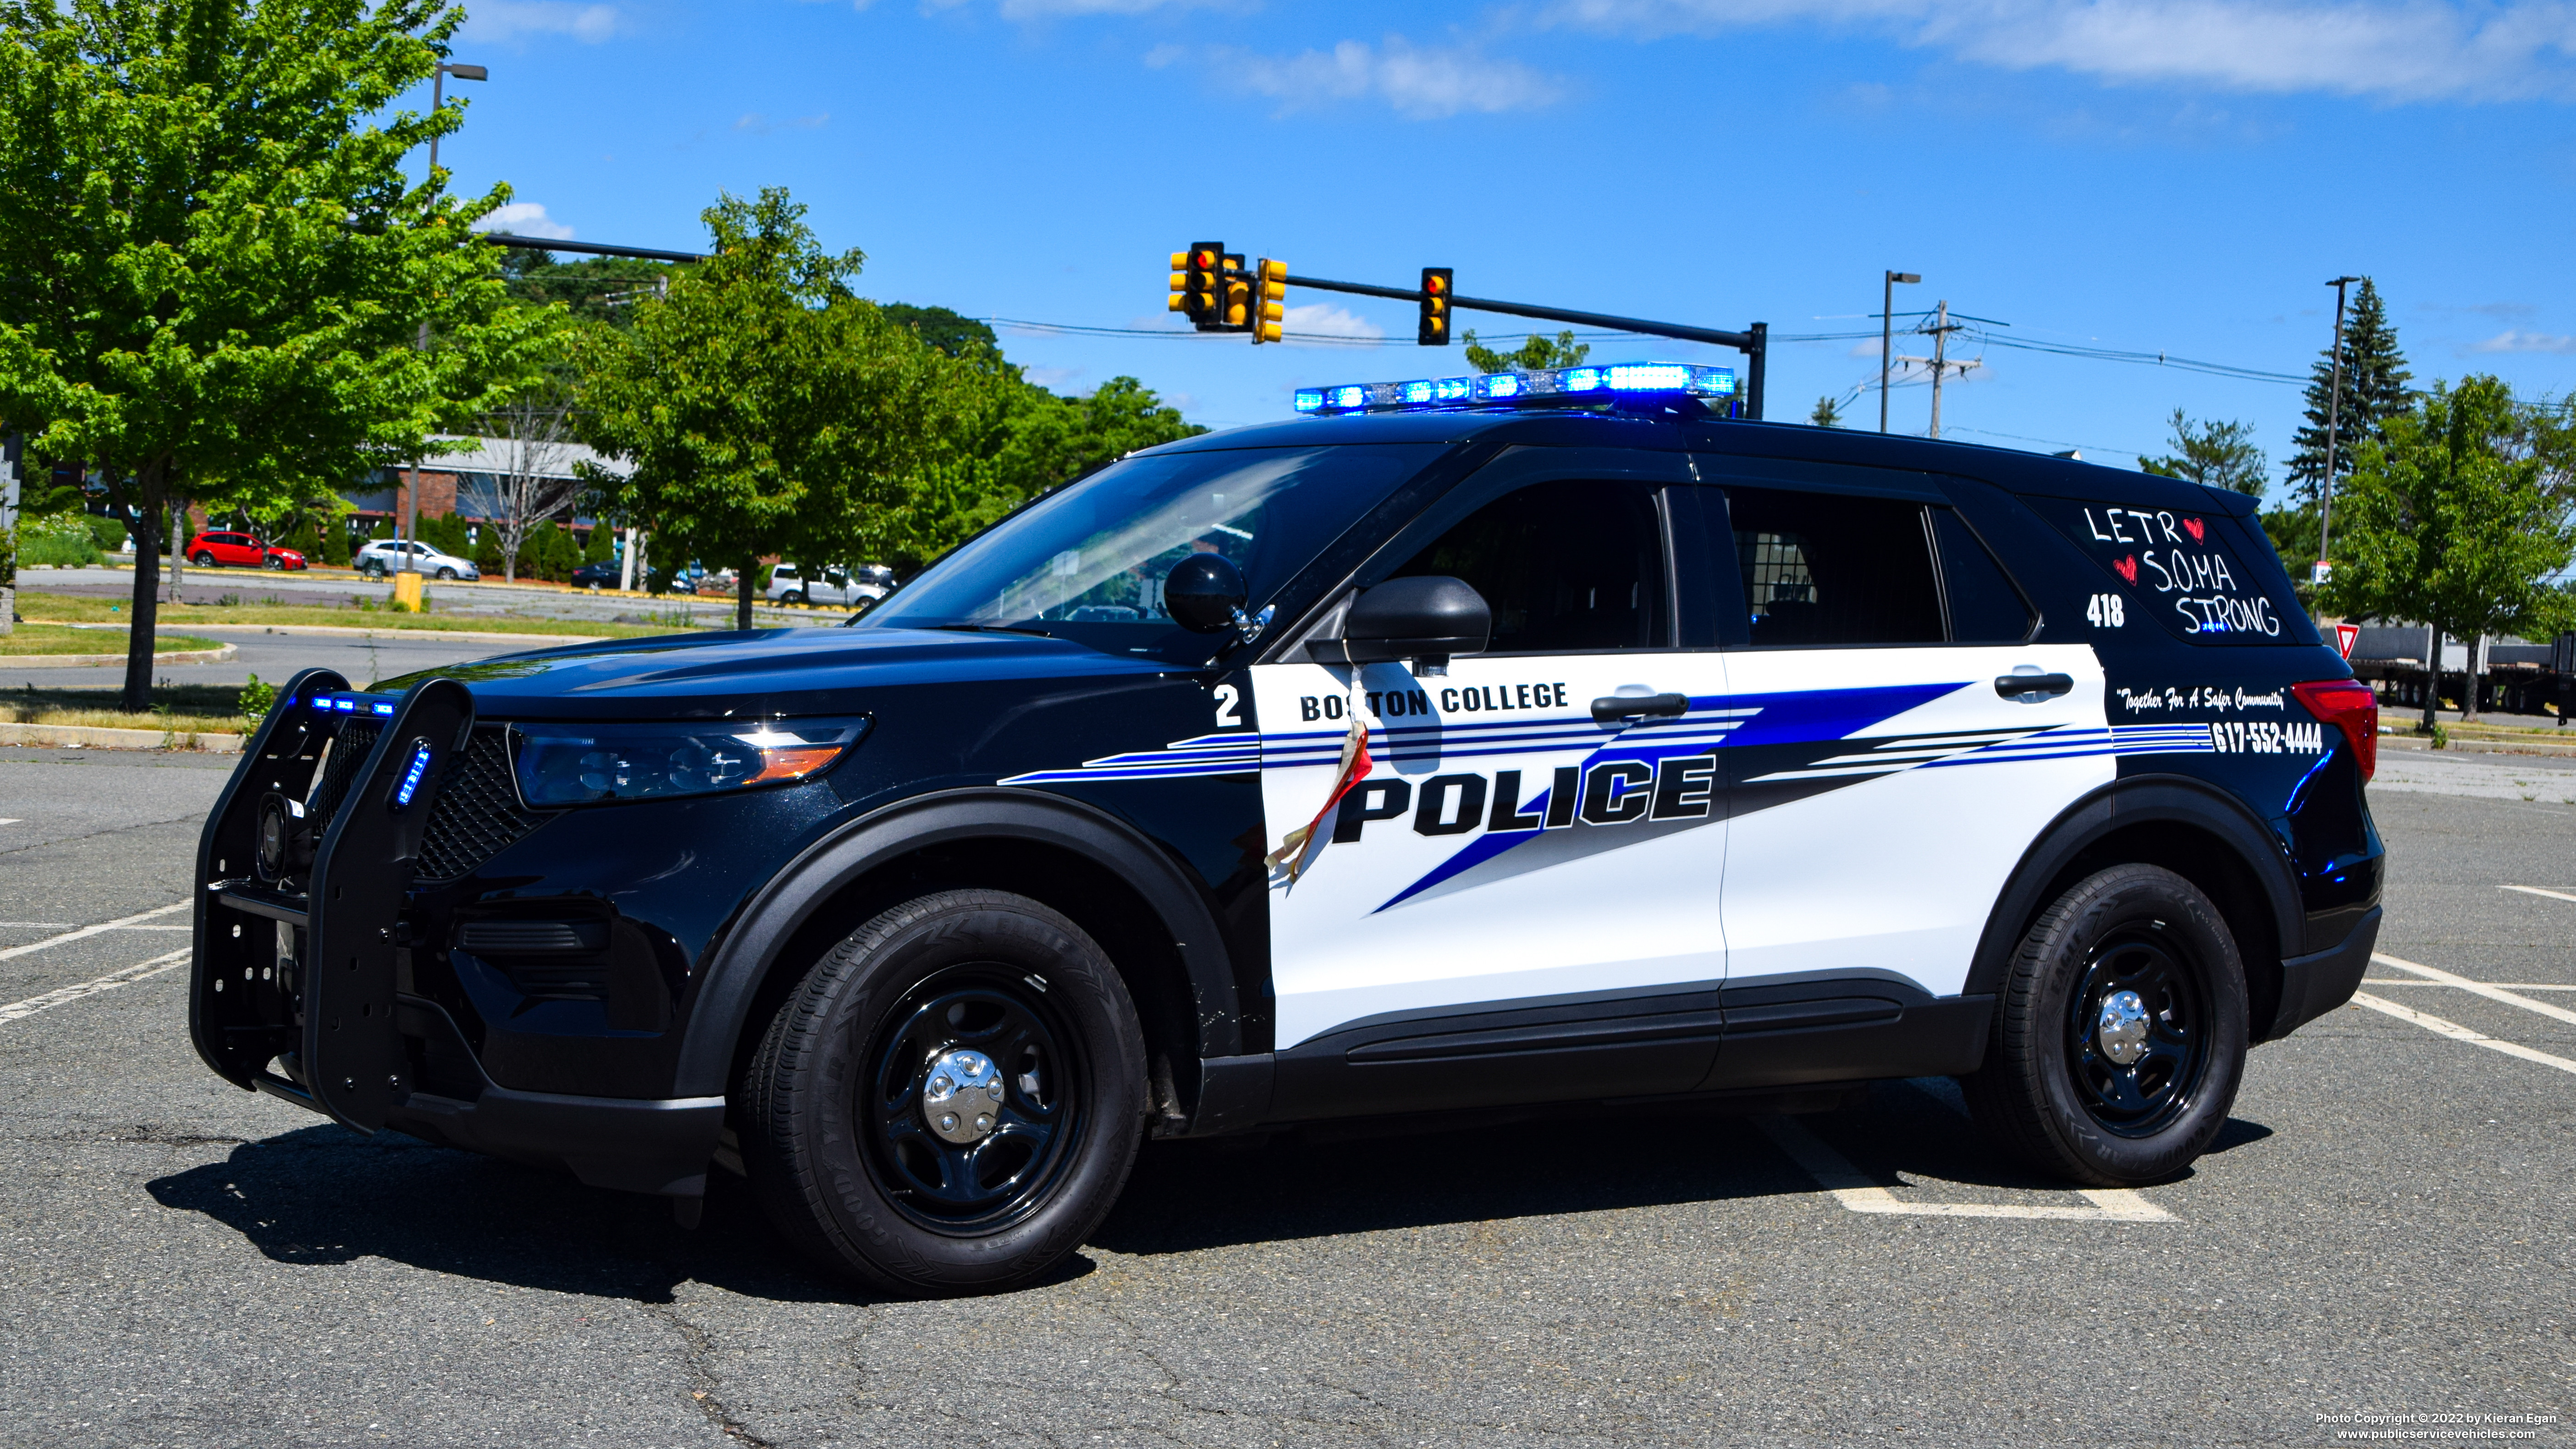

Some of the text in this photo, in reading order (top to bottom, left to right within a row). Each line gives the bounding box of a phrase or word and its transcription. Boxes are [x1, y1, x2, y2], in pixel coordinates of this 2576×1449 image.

[2085, 508, 2182, 544] LETR
[2087, 594, 2124, 627] 418
[2176, 595, 2280, 636] STRONG
[1214, 684, 1241, 727] 2
[1300, 682, 1569, 722] BOTON COLLEGE
[2166, 687, 2184, 711] For
[2190, 688, 2198, 708] A
[2204, 687, 2231, 712] Safer
[2213, 722, 2322, 755] 617-552-4444
[1331, 755, 1716, 844] POLICE
[821, 1056, 889, 1246] GOODYEAR
